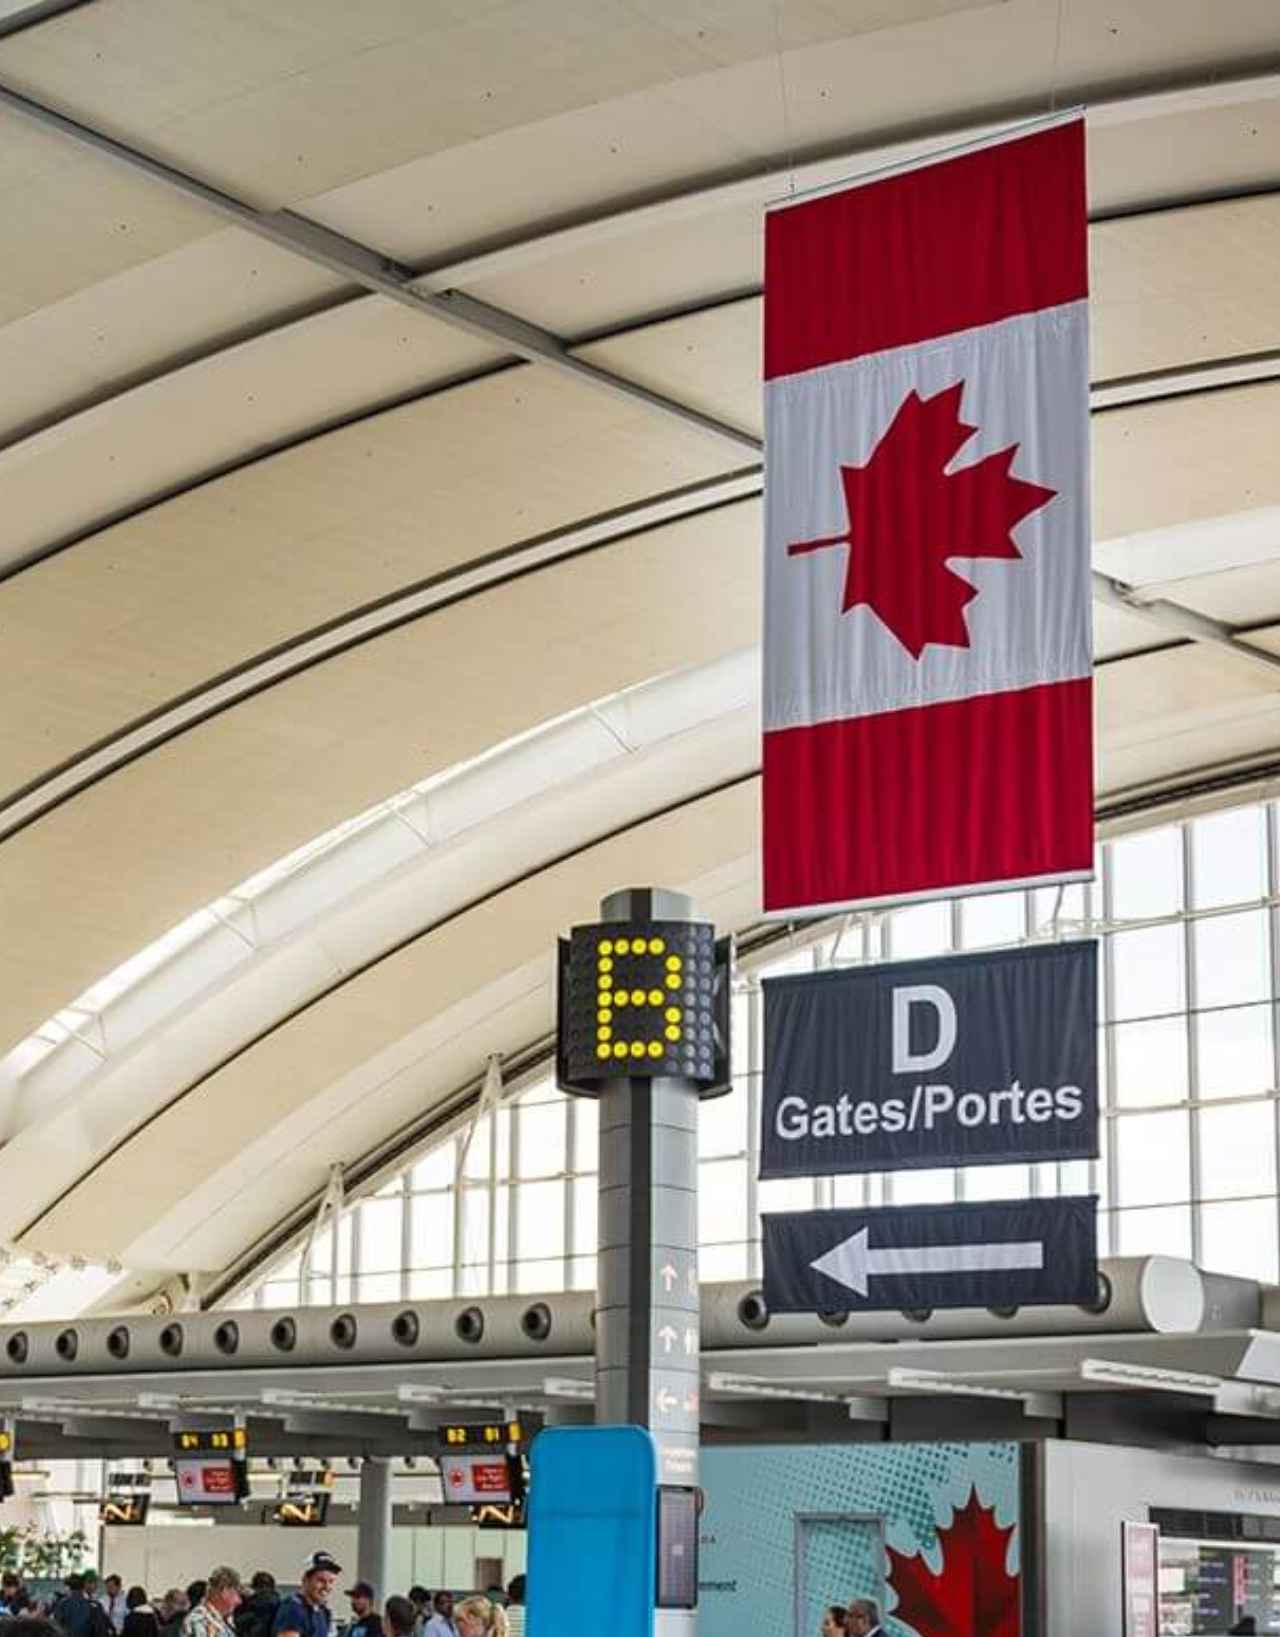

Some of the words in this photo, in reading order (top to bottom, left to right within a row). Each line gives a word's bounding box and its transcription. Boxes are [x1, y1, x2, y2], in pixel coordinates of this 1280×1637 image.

[596, 938, 682, 1060] B
[891, 984, 958, 1075] D
[774, 1081, 1083, 1141] Gates/Portes
